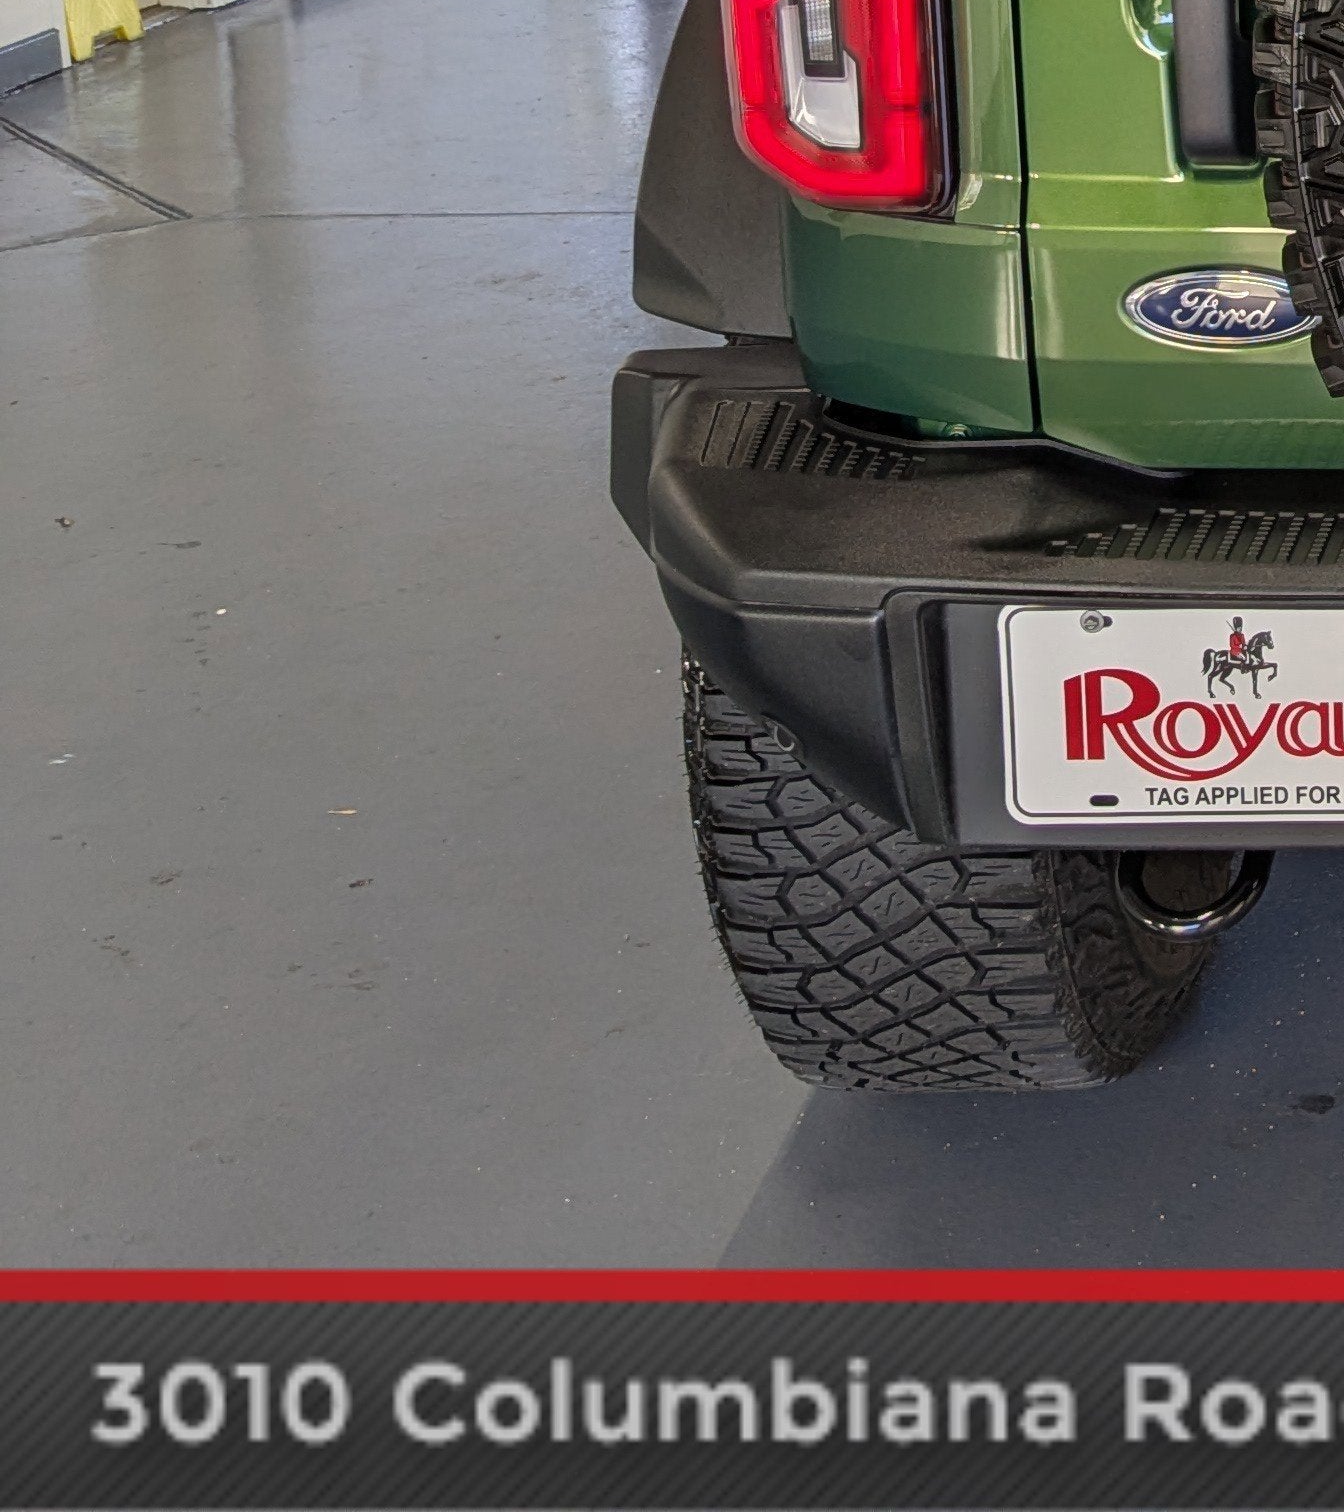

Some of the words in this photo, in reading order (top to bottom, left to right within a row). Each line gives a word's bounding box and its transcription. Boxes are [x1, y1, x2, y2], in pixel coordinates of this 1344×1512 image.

[1171, 288, 1277, 331] Ford
[1145, 787, 1189, 806] TAG
[1195, 786, 1289, 806] APPLIED
[1296, 785, 1341, 804] FOR
